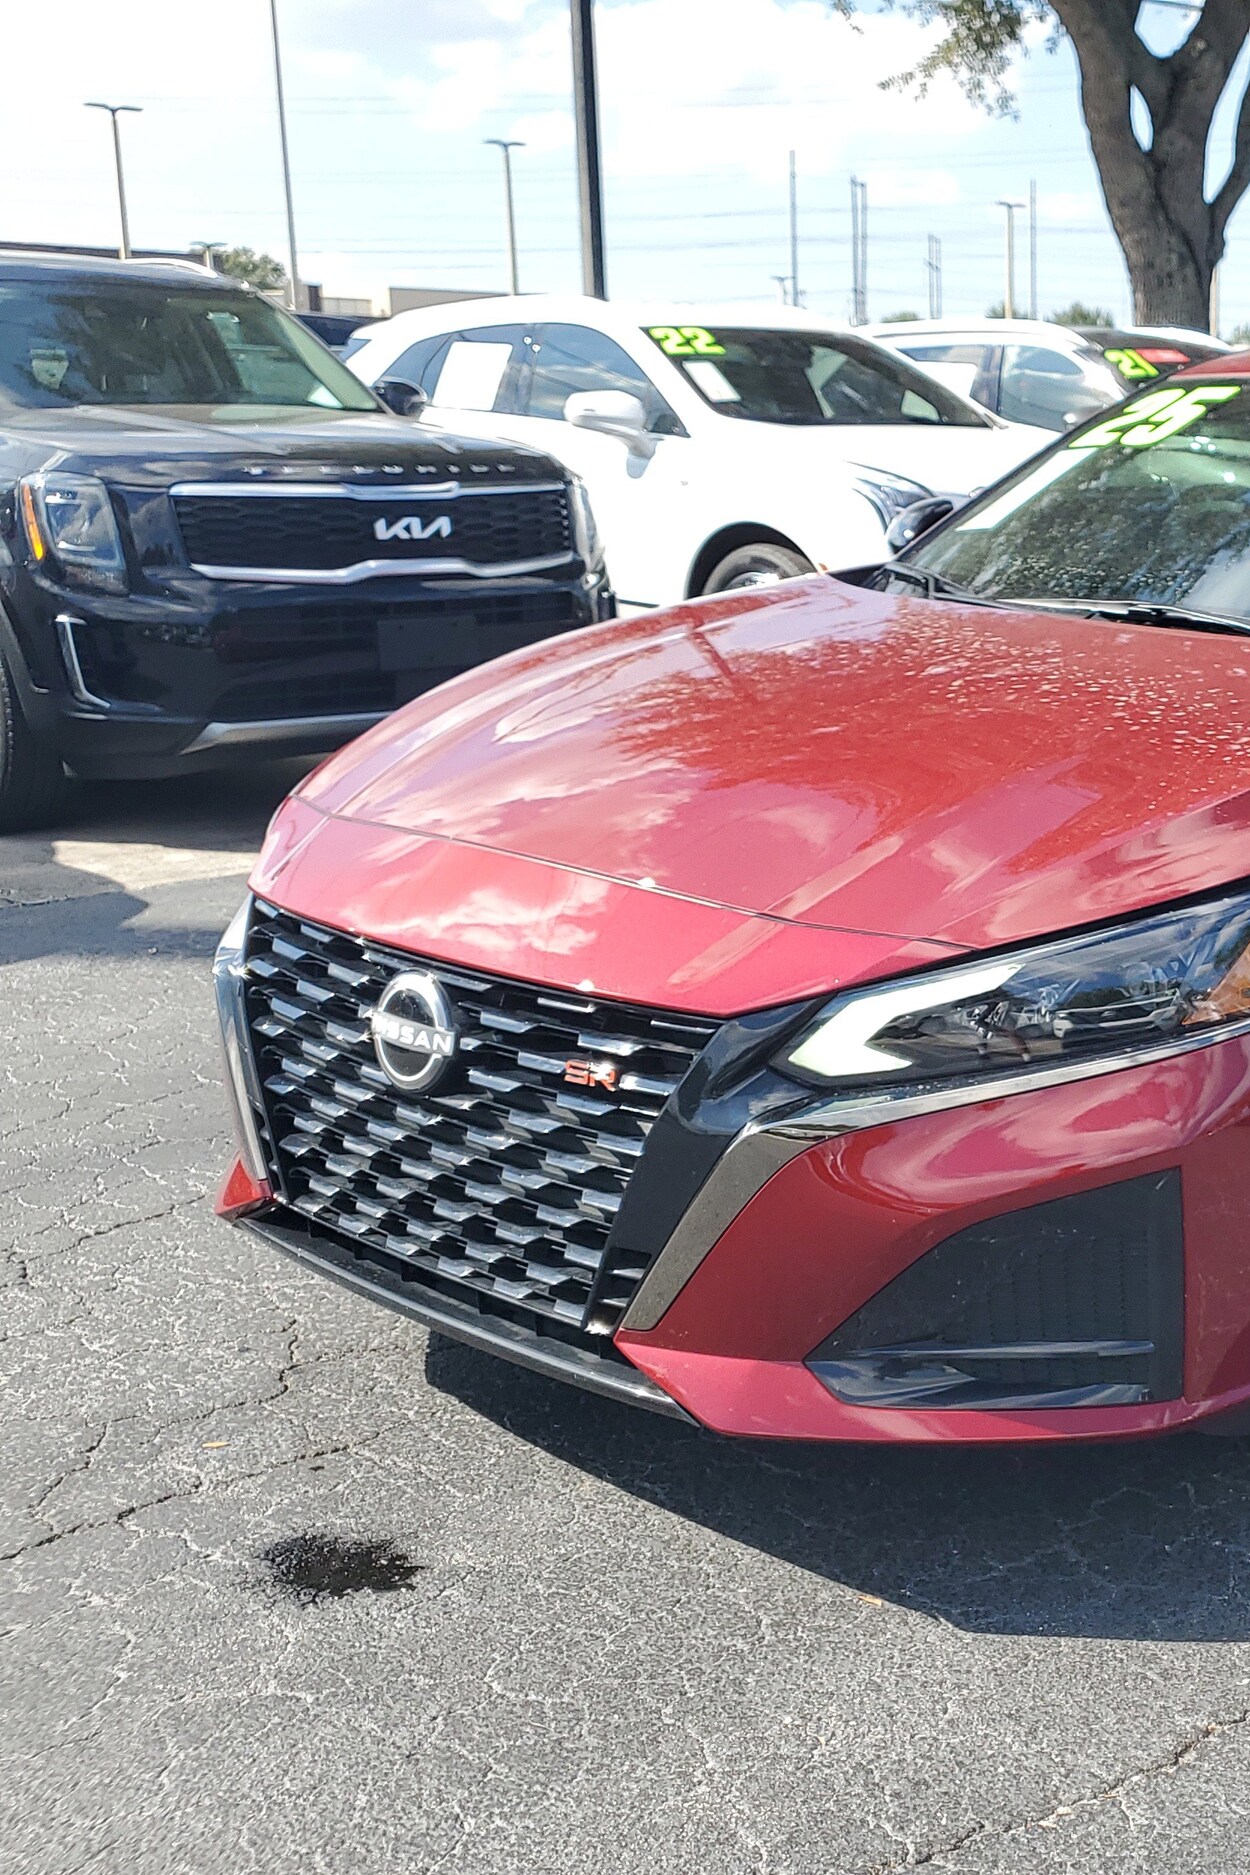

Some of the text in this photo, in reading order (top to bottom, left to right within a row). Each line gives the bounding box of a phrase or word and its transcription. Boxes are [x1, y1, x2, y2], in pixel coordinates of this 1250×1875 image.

[649, 326, 726, 356] 22
[1103, 348, 1160, 379] 21
[1068, 385, 1242, 448] 25
[373, 515, 452, 541] KIA
[564, 1059, 617, 1092] SR
